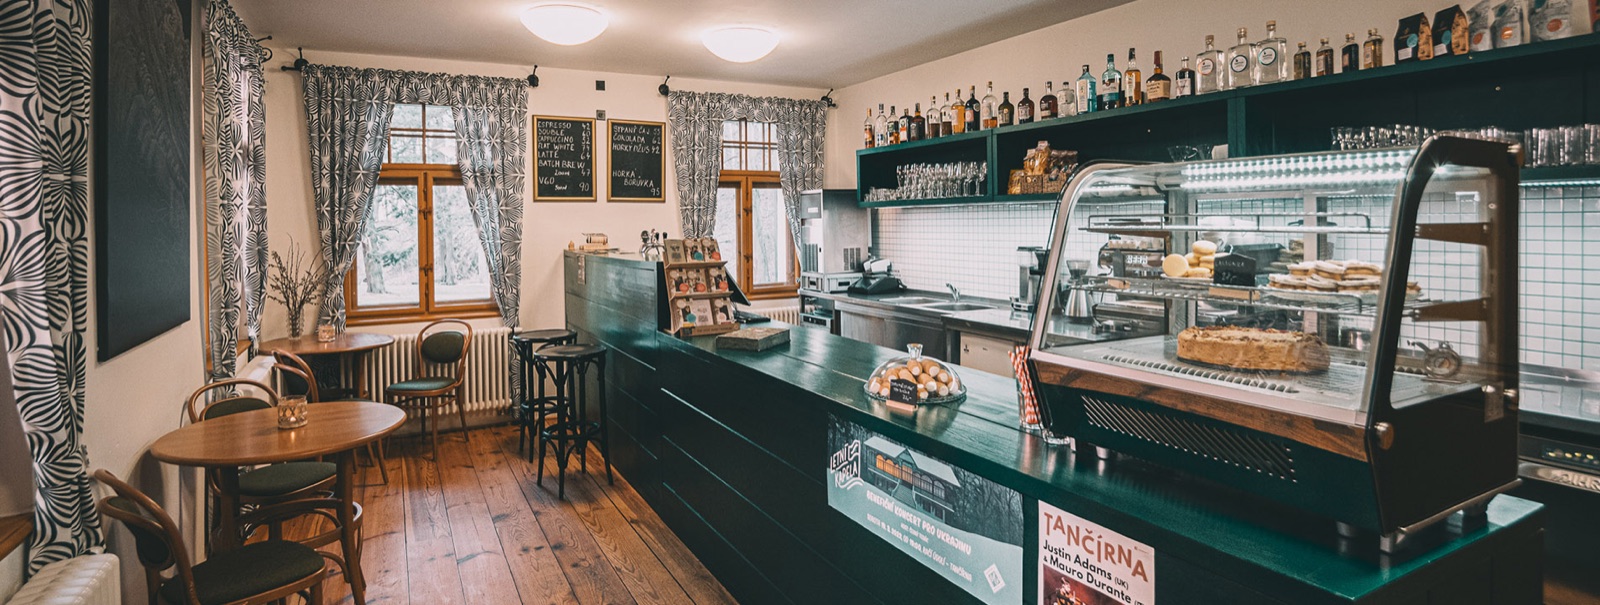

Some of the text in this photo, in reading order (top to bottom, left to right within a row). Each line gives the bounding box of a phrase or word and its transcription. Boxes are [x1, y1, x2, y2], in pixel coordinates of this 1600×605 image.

[538, 121, 571, 129] ESPRESSO
[638, 126, 650, 134] ČAJ
[554, 144, 574, 152] WHITE
[562, 160, 586, 169] BREW
[579, 182, 590, 192] 90
[650, 188, 660, 196] 95
[866, 490, 894, 512] BENEFIČNÍ
[894, 504, 922, 528] KONCERT
[922, 520, 936, 536] PRO
[936, 528, 972, 555] UKRAJINU
[1044, 511, 1148, 583] TANČÍRNA
[1043, 540, 1129, 592] Justin Adams (UK)
[1050, 554, 1084, 580] Mauro
[1086, 572, 1132, 604] Durante
